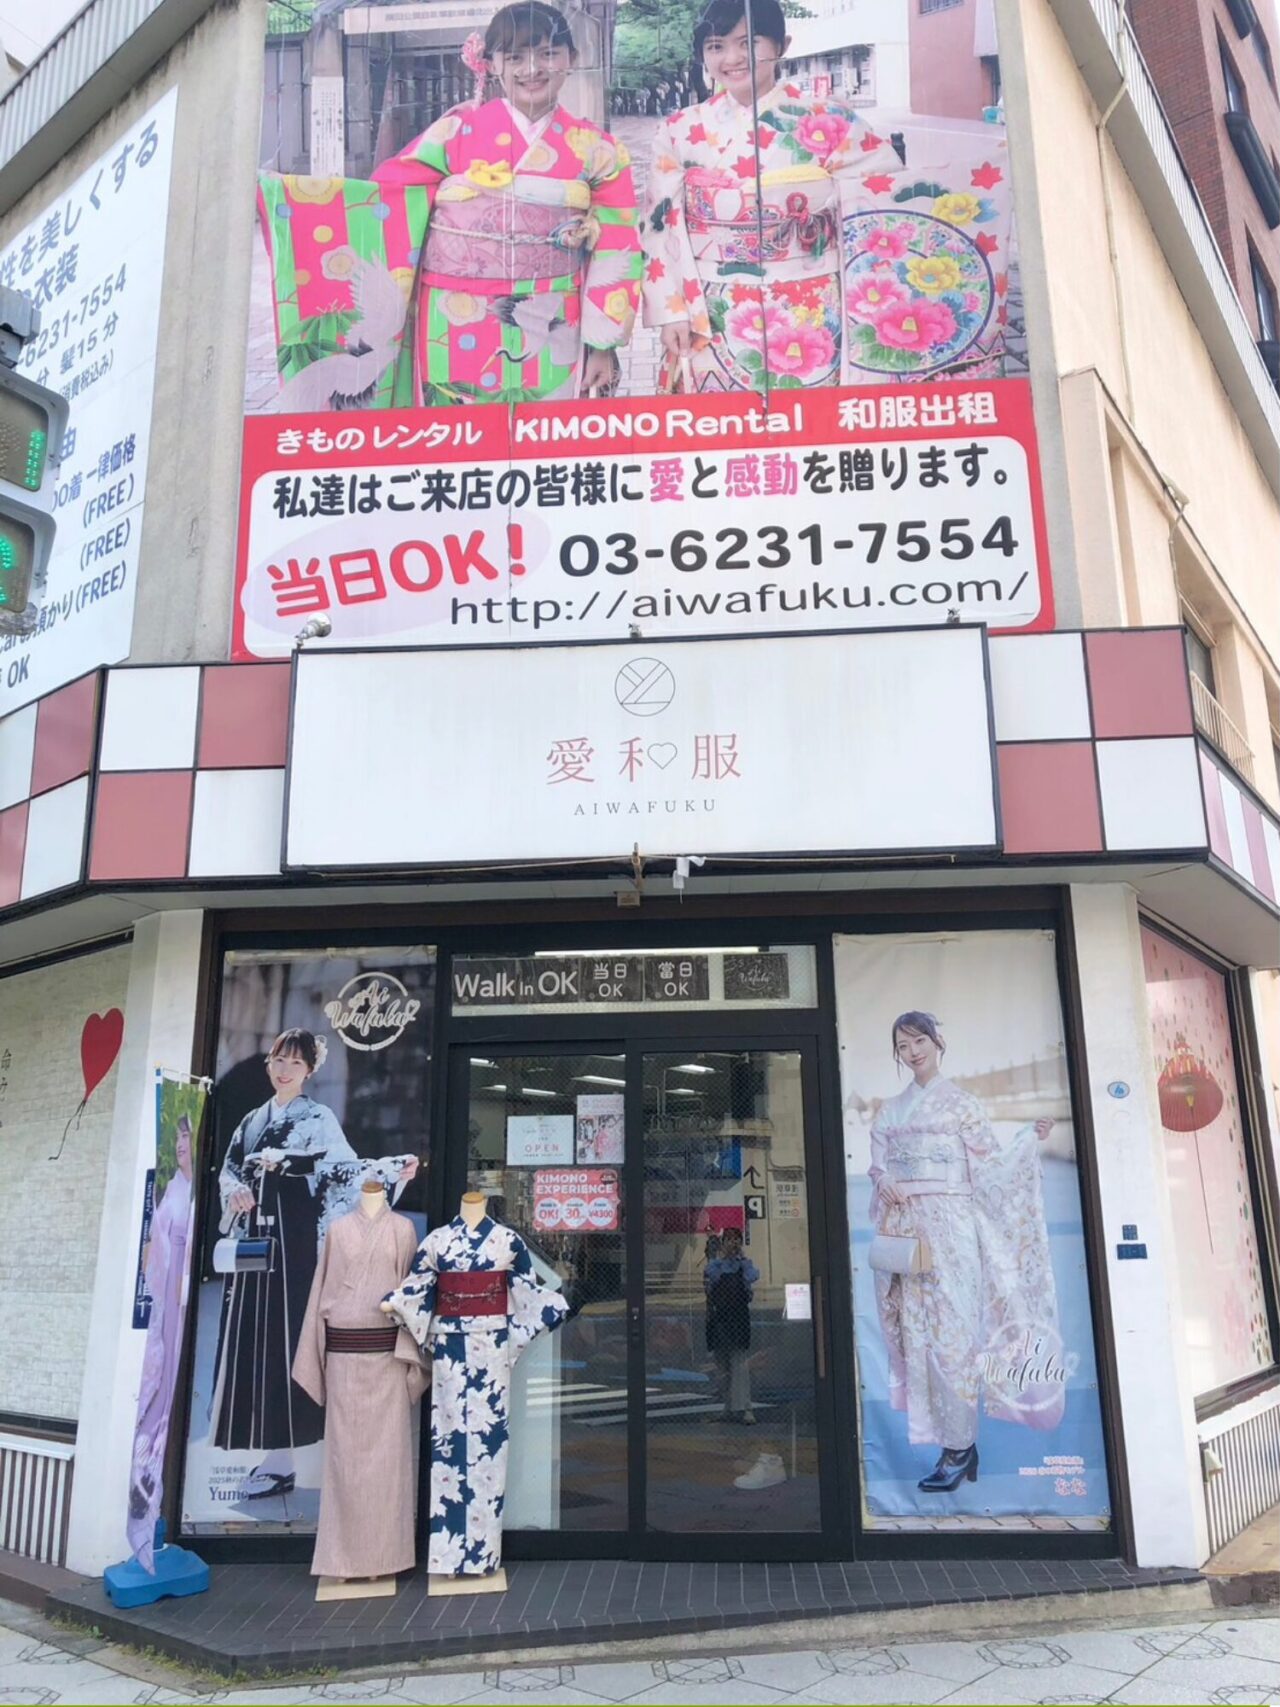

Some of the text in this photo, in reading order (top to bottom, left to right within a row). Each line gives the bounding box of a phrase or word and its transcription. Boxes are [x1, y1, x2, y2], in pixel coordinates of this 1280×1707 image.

[21, 243, 80, 310] 衣装
[276, 391, 998, 455] きものレンタル KIMONO Rental 和服出租
[273, 441, 1009, 520] 私達はご来店の皆様に愛と感動を贈ります。
[83, 472, 135, 529] (FREE)
[80, 517, 131, 572] (FREE)
[266, 516, 1019, 617] 当日OK! 03-6231-7554
[451, 571, 1029, 629] http://aiwafuku.com/
[7, 653, 31, 689] OK
[573, 798, 717, 816] AIWAFUKU
[454, 972, 515, 998] Walk
[538, 970, 578, 996] OK
[593, 962, 628, 980] 当日
[598, 982, 623, 998] OK
[664, 981, 690, 997] OK
[525, 1144, 561, 1153] OPEN
[536, 1173, 588, 1184] KIMONO
[536, 1184, 614, 1195] EXPERIENCE
